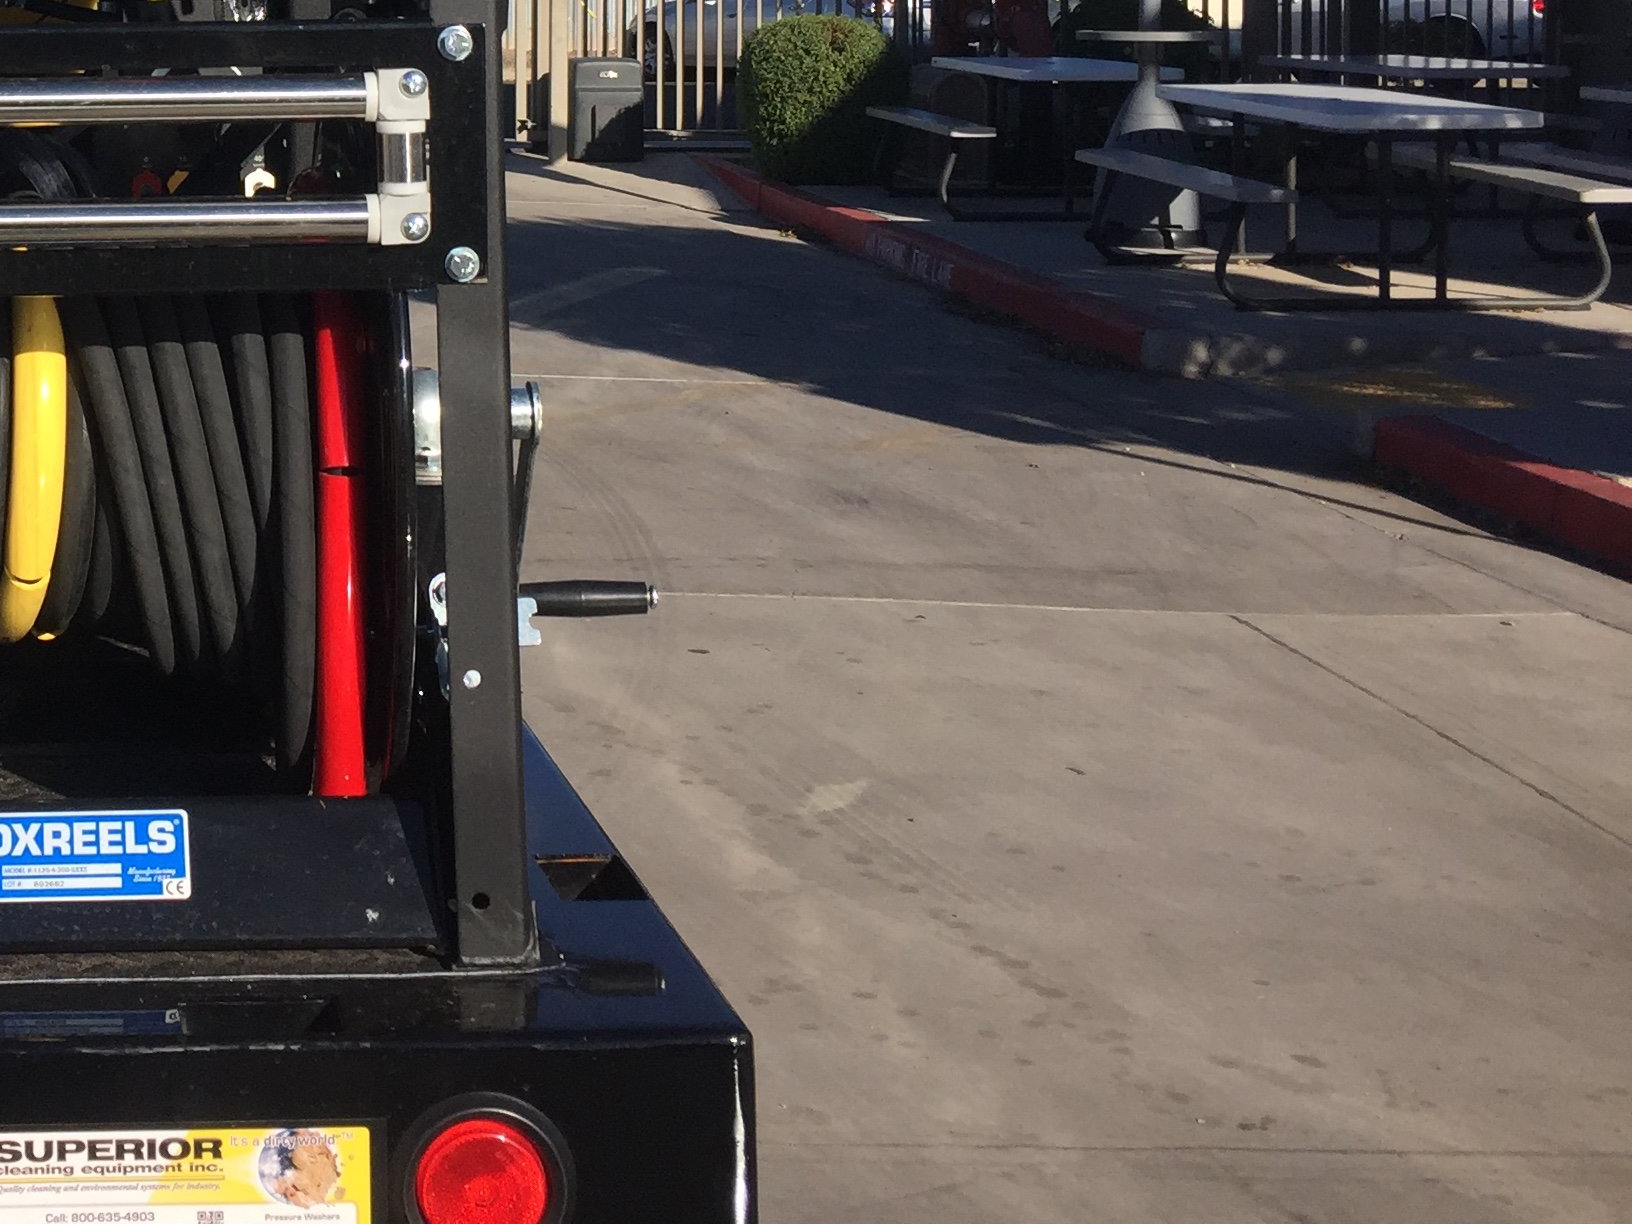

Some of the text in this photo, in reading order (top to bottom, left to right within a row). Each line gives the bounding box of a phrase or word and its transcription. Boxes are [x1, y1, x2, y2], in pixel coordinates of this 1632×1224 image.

[264, 1135, 295, 1149] dirty
[81, 1162, 183, 1176] equipment
[189, 1162, 224, 1173] inc.
[27, 1184, 62, 1194] cleaning
[63, 1184, 79, 1192] and
[80, 1182, 139, 1192] environmental
[140, 1183, 170, 1192] systems
[172, 1182, 184, 1192] for
[45, 1211, 155, 1223] Call: 800-635-4903
[264, 1212, 341, 1221] Pressure Washers
